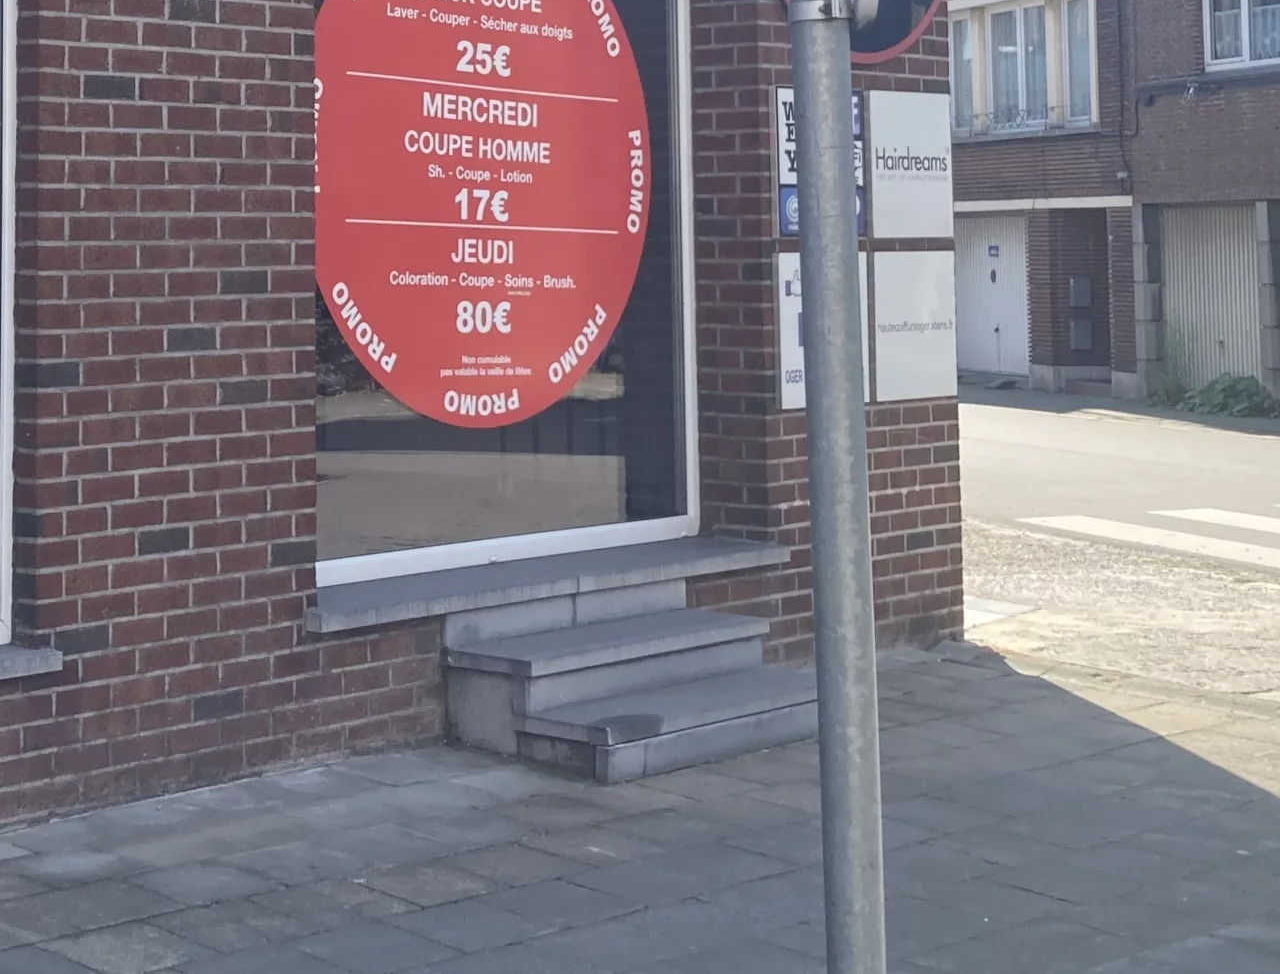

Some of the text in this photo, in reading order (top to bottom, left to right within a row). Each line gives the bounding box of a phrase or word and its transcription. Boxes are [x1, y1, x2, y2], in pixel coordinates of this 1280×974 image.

[386, 3, 419, 20] Laver
[429, 8, 470, 28] Couper
[480, 15, 517, 33] Sécher
[519, 24, 539, 36] aux
[541, 23, 573, 41] doigts
[456, 40, 511, 77] 25€
[423, 91, 539, 128] MERCREDI
[404, 129, 551, 164] COUPE HOMME
[875, 145, 948, 172] Hairdreams
[427, 164, 446, 178] Sh.
[455, 166, 491, 183] Coupe
[500, 169, 533, 184] Lotion
[627, 129, 645, 234] PROMO
[454, 188, 509, 222] 17€
[451, 239, 514, 264] JEUDI
[389, 270, 449, 286] Coloration
[458, 272, 495, 289] Coupe
[504, 274, 534, 288] Soins
[543, 275, 577, 289] Brush.
[332, 282, 398, 373] PROMO
[456, 300, 512, 334] 80€
[461, 355, 476, 364] Non
[548, 303, 607, 384] PROMO
[443, 388, 520, 417] PROMO
